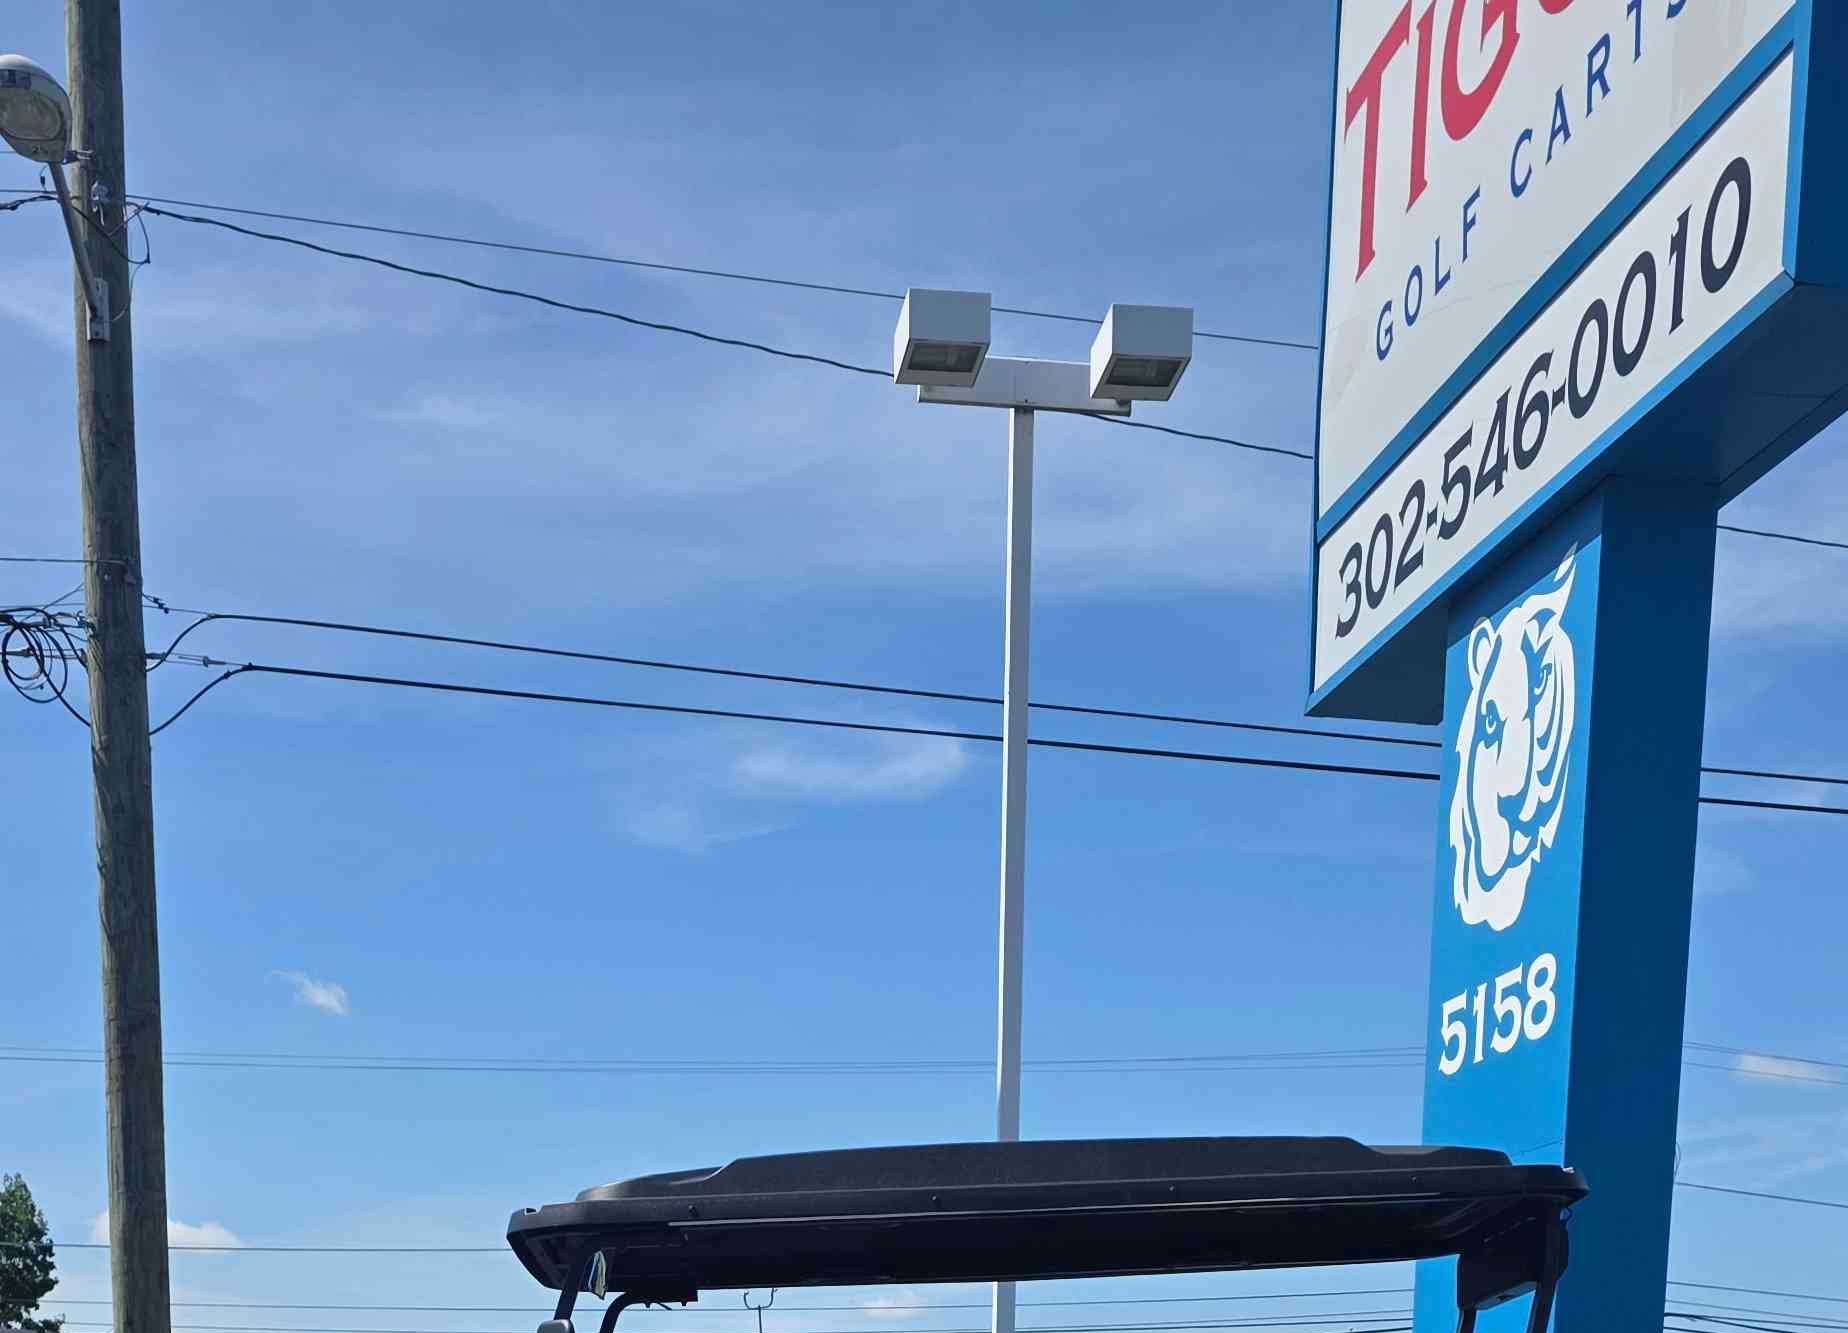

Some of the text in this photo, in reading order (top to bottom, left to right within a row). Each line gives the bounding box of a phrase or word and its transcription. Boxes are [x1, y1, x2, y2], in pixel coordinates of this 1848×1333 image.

[1344, 0, 1574, 283] TIG
[1376, 186, 1481, 361] GOLF
[1335, 156, 1752, 639] 302-546-0010
[1438, 952, 1557, 1075] 5158
